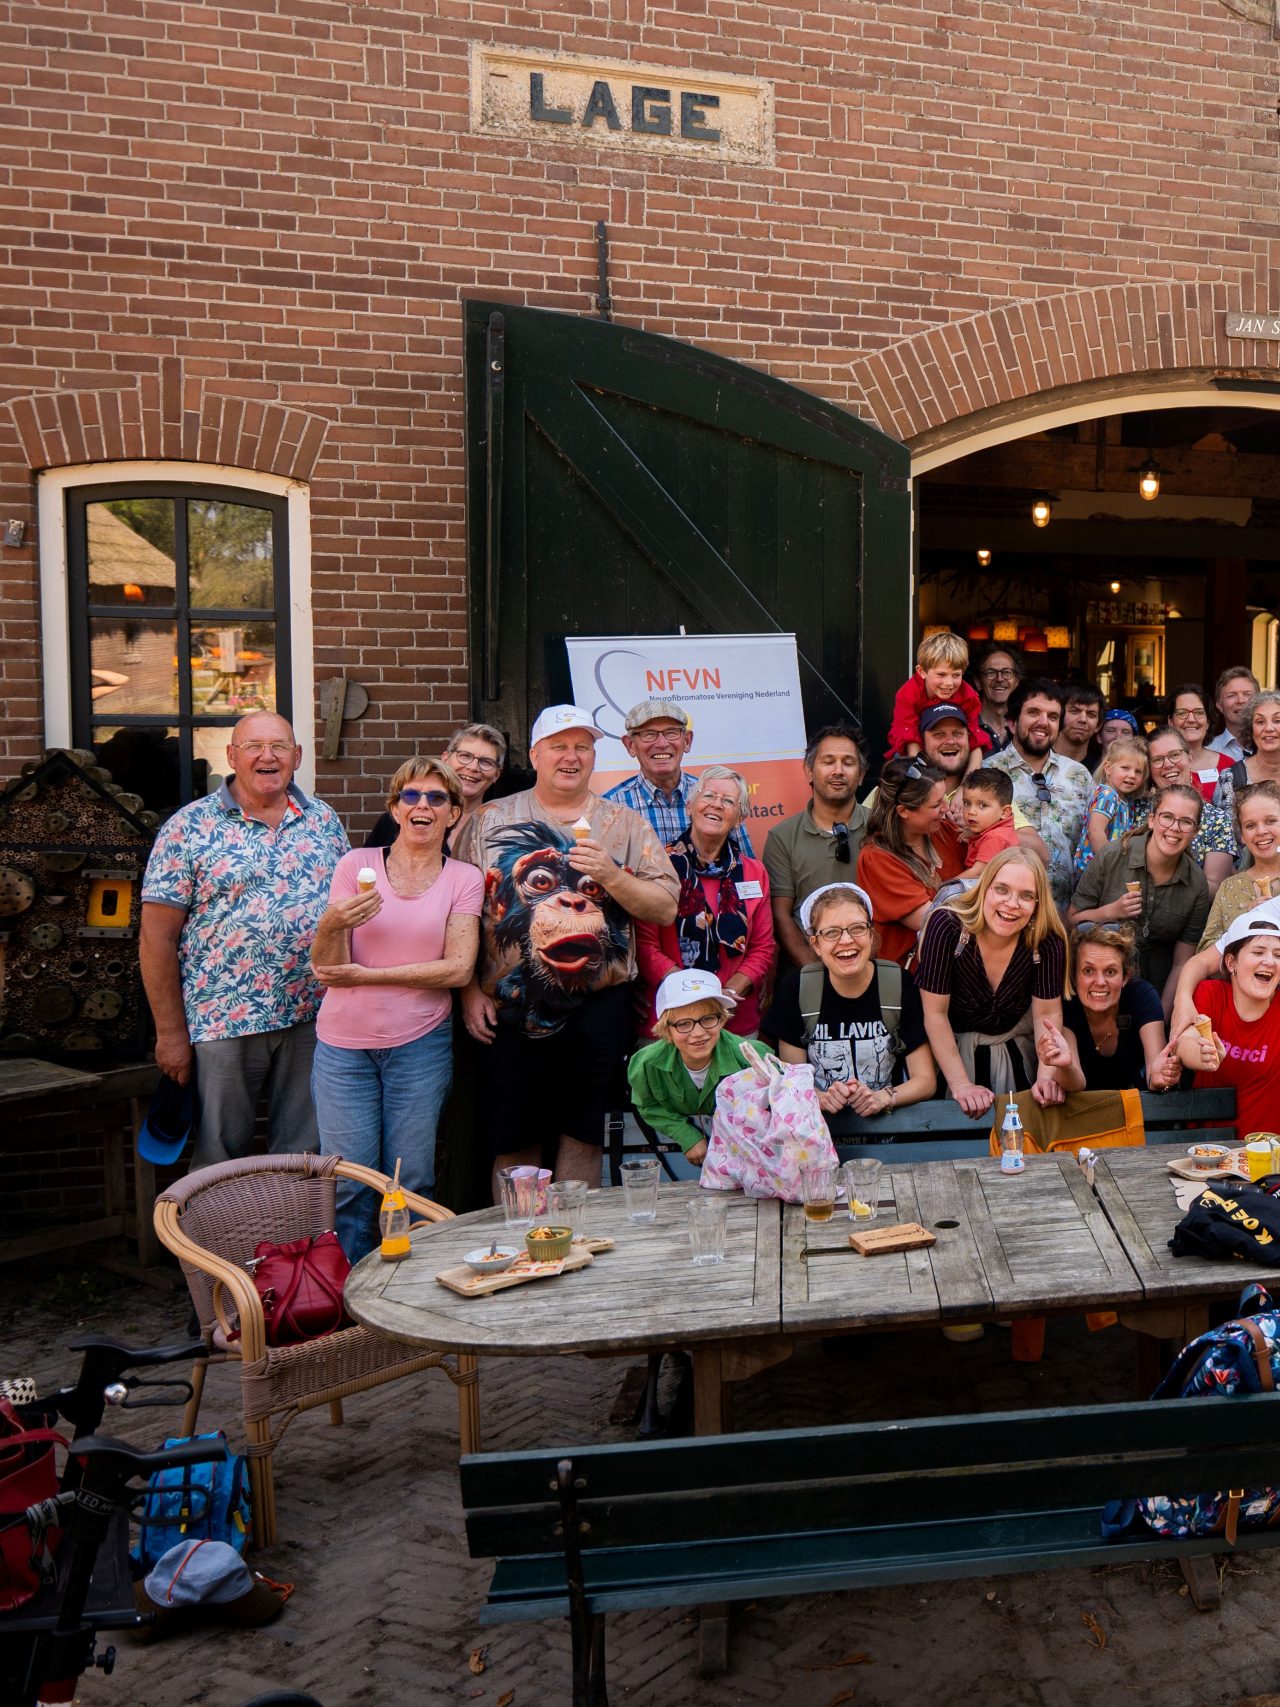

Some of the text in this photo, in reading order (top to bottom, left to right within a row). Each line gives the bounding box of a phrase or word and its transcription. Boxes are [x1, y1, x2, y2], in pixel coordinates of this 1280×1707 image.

[530, 73, 721, 142] LAGE
[1235, 318, 1266, 333] JAN
[645, 667, 721, 692] NFVN
[716, 691, 754, 701] Vereniging
[755, 689, 791, 698] Nederland
